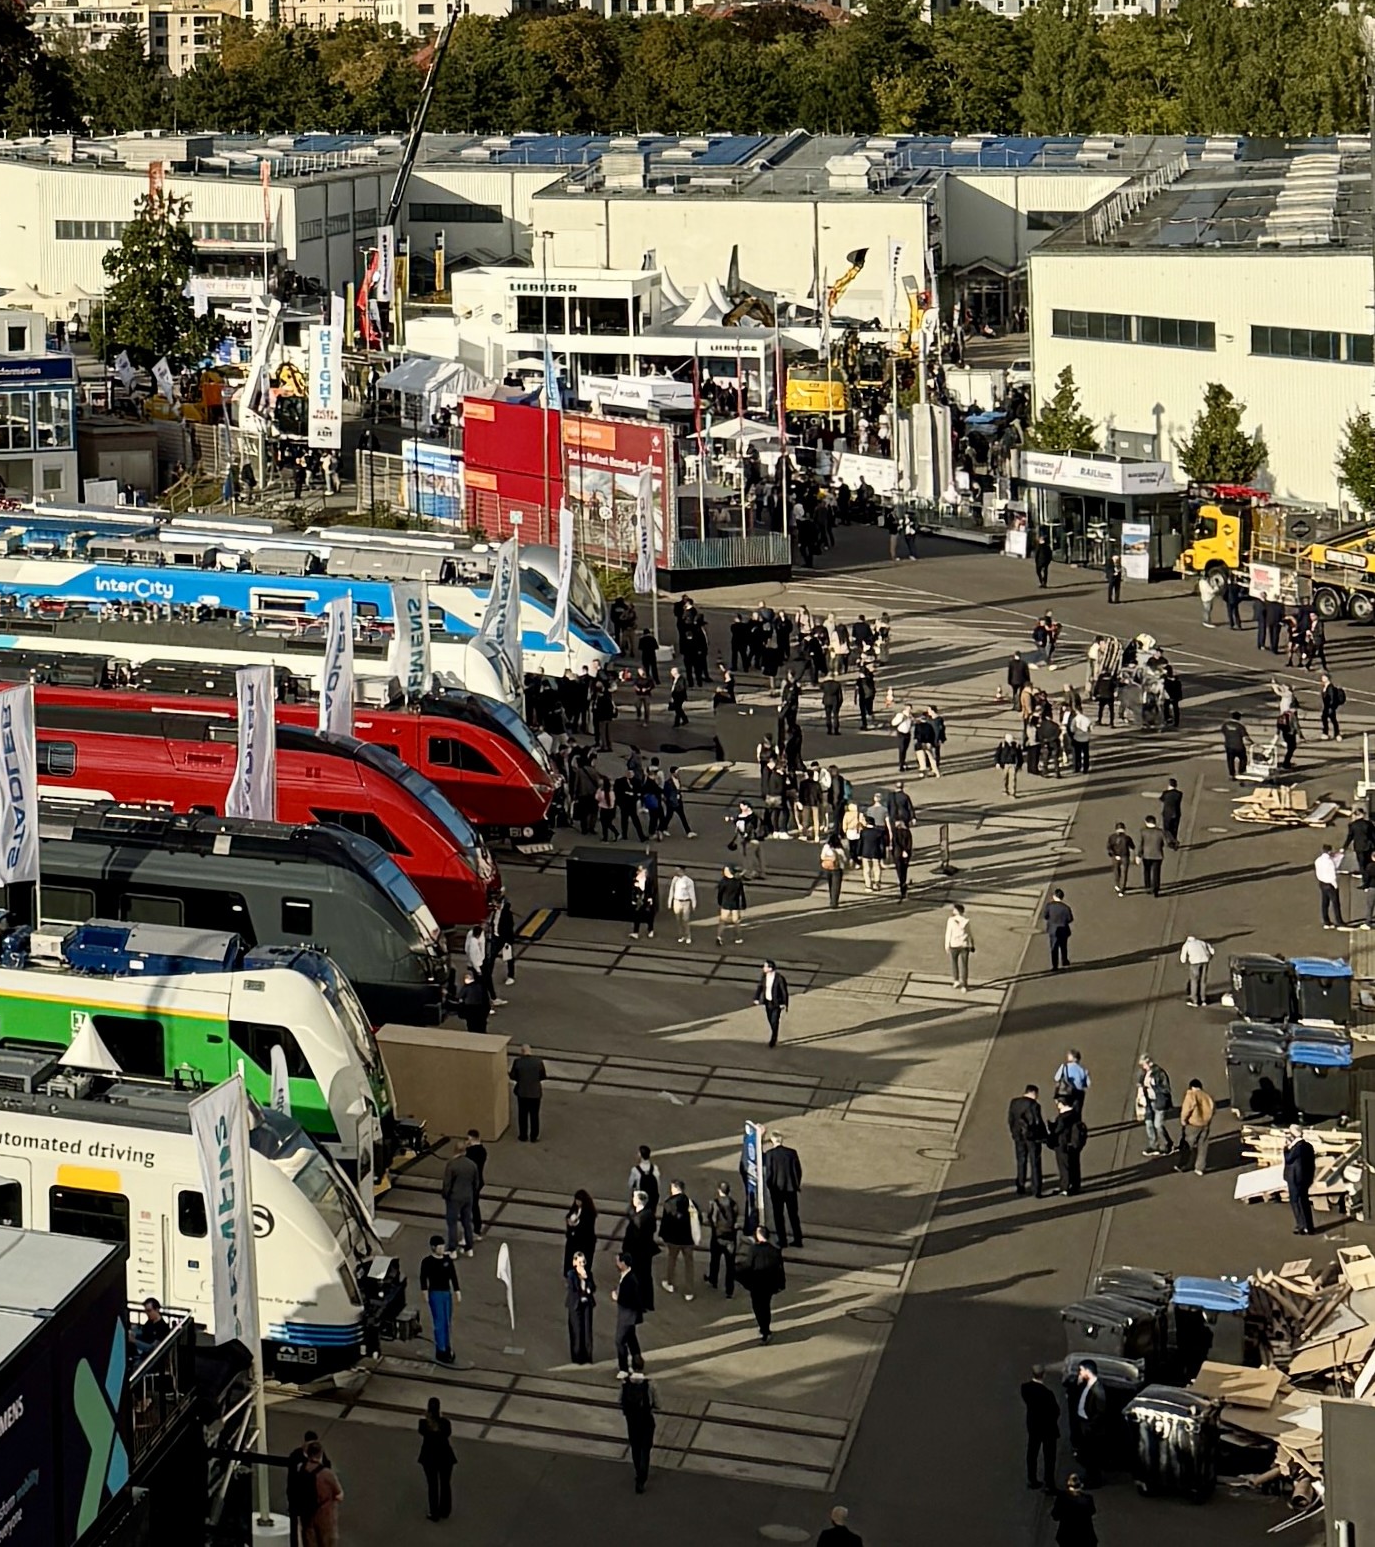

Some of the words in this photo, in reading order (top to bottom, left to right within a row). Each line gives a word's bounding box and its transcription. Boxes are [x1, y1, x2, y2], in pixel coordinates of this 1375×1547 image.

[510, 283, 577, 292] LIEBHERR
[319, 330, 332, 408] HEIGHT
[95, 575, 174, 599] interCity
[87, 1141, 156, 1168] driving
